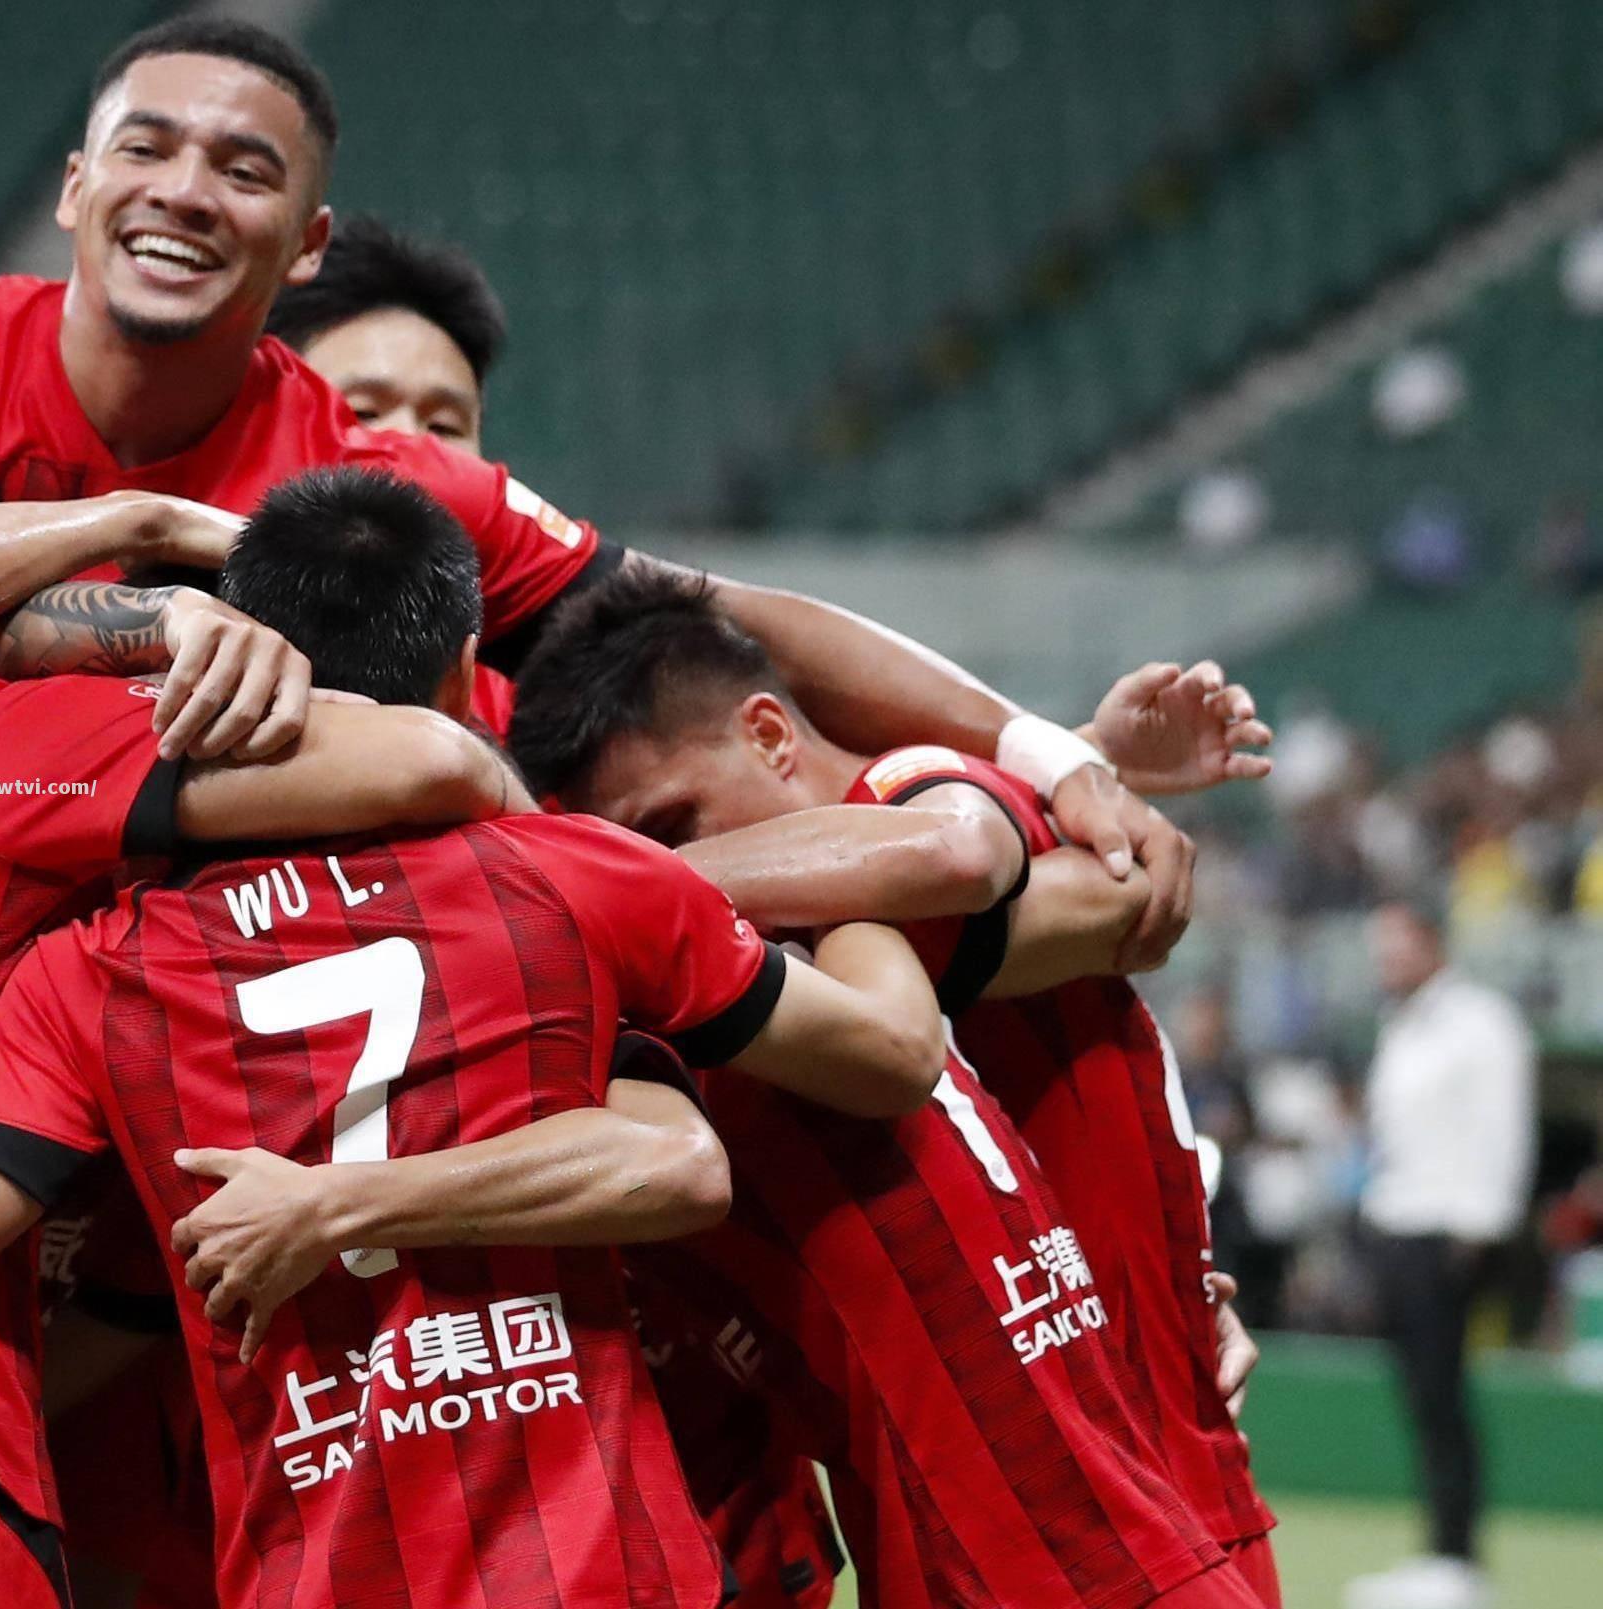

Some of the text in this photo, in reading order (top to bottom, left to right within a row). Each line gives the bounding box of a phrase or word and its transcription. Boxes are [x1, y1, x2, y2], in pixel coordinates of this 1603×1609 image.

[222, 856, 384, 939] WU L.
[234, 935, 427, 1279] 7
[1012, 1308, 1082, 1365] SAIC
[379, 1372, 584, 1443] MOTOR
